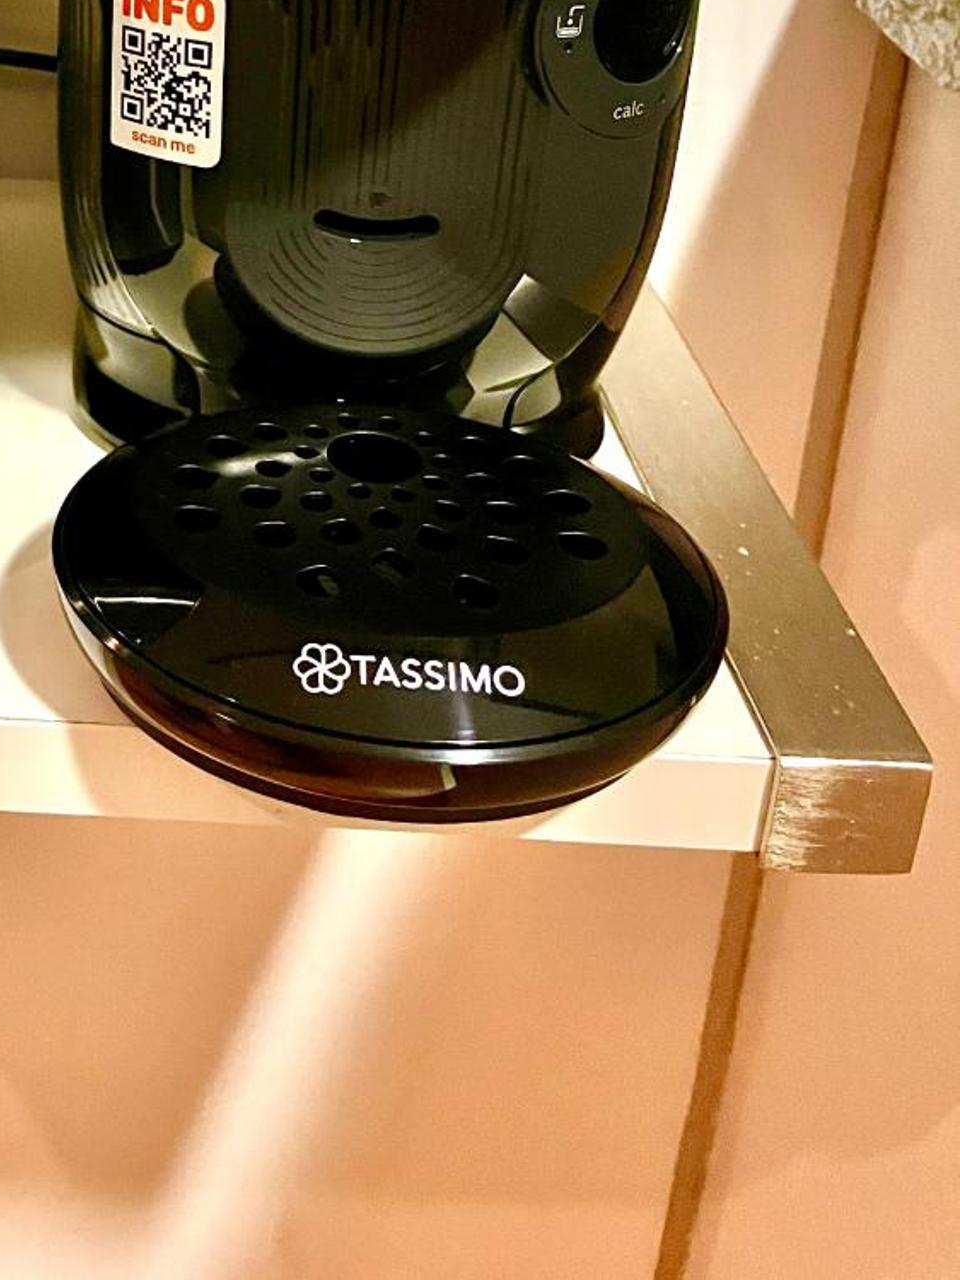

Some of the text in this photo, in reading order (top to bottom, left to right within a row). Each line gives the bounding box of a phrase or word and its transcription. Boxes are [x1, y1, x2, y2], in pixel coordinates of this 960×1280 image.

[613, 100, 644, 120] calc
[131, 130, 196, 154] scan me
[349, 654, 526, 697] TASSIMO
